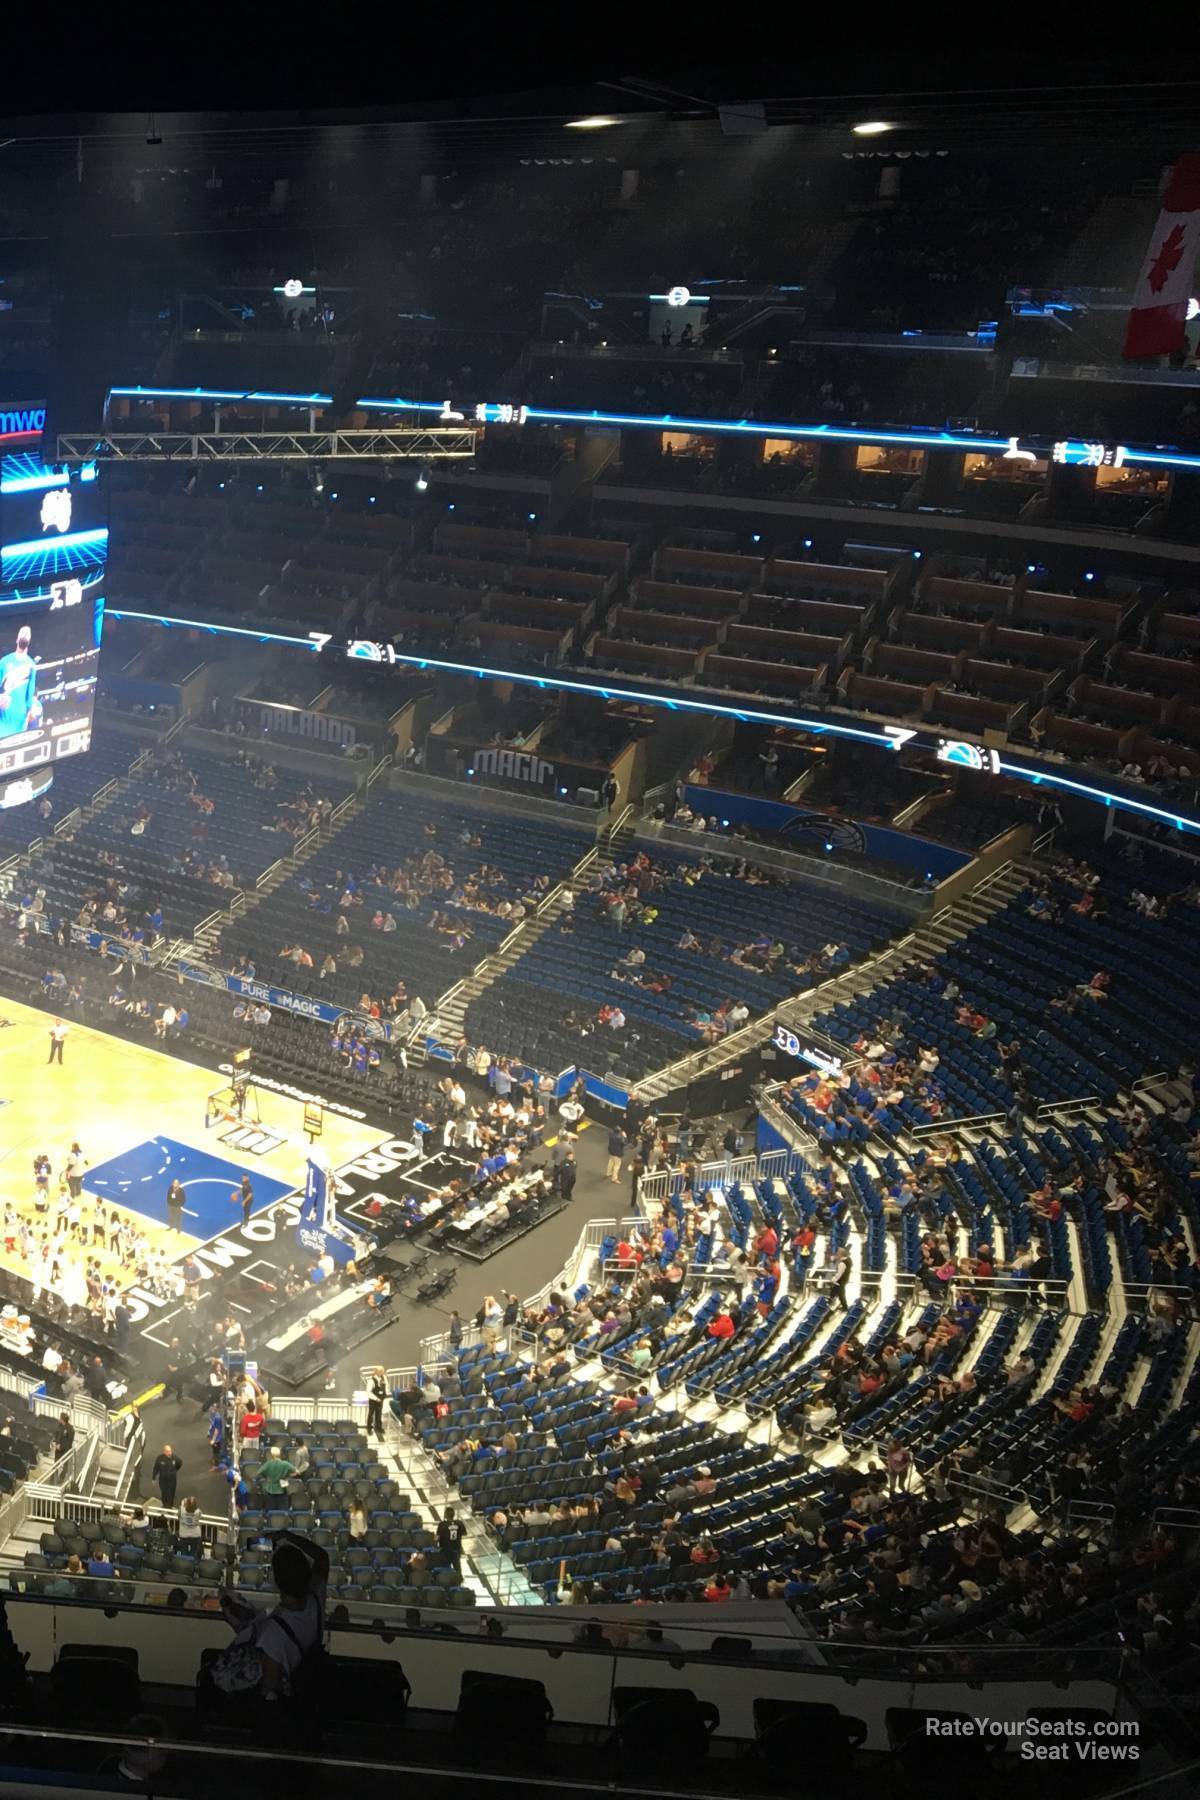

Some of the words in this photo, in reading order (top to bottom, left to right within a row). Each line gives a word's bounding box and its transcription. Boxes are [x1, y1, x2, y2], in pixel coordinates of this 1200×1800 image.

[473, 750, 554, 785] MAGIC
[240, 982, 270, 1001] PURE
[281, 996, 321, 1016] MAGIC
